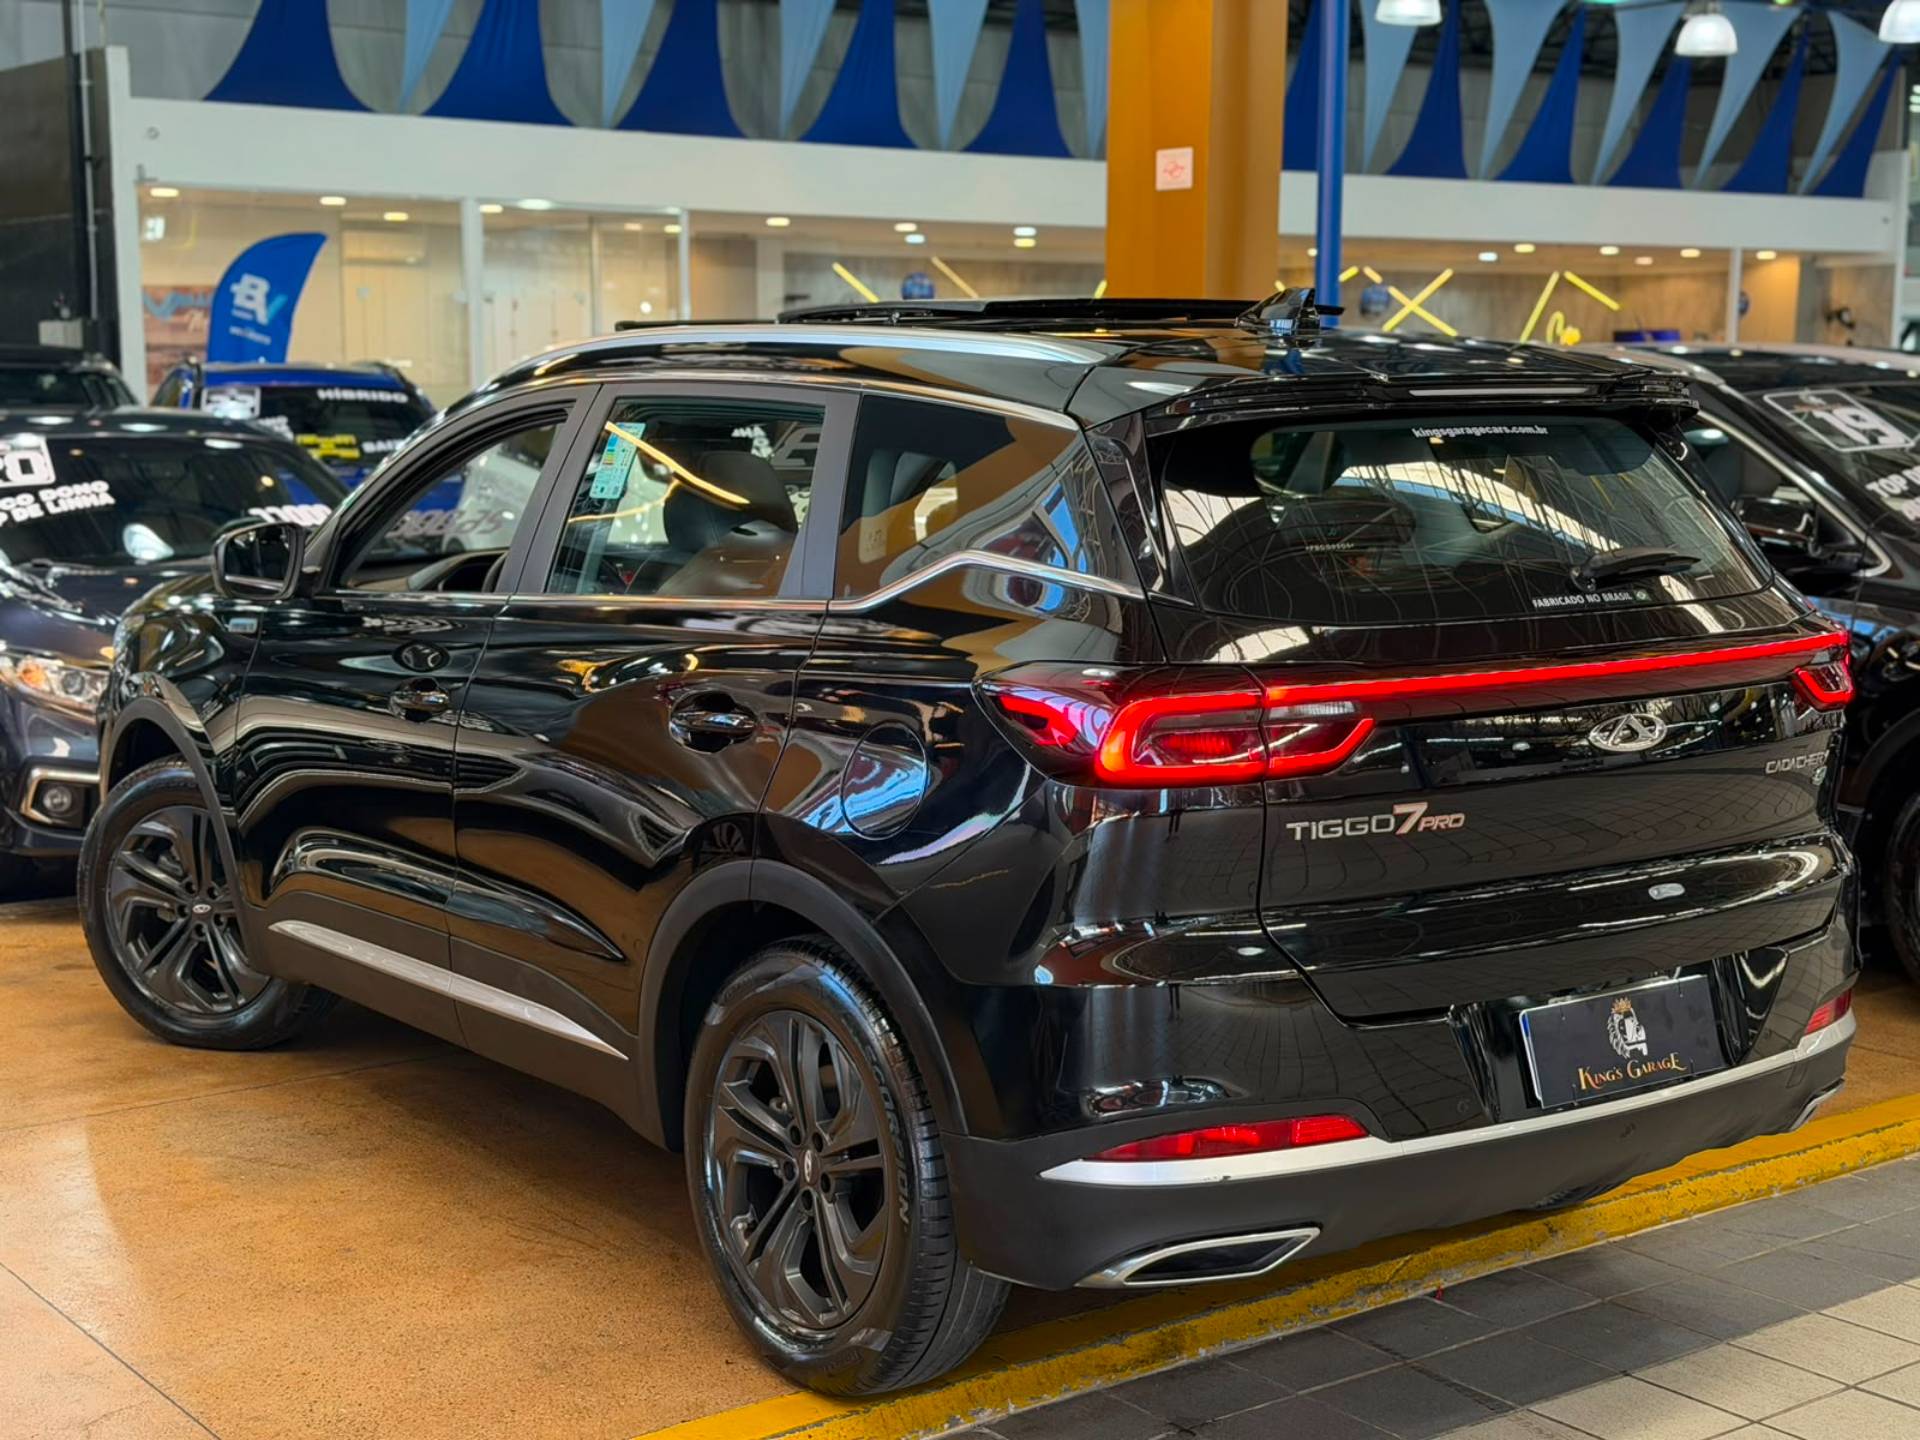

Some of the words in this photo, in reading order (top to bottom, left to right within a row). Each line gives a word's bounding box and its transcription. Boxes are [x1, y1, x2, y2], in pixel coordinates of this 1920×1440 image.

[1411, 425, 1548, 438] kingsgaragecars.com.br
[1811, 406, 1906, 446] 19
[38, 480, 109, 503] DONO
[1865, 473, 1909, 498] TOP
[45, 493, 115, 514] LINHA
[1532, 595, 1585, 608] FABRICADO
[1585, 593, 1601, 603] NO
[1602, 592, 1632, 602] BRASIL
[1286, 814, 1395, 841] TIGGO
[1393, 801, 1428, 835] 7
[1417, 813, 1465, 832] PRO
[1578, 1066, 1623, 1091] KING'S
[1626, 1052, 1687, 1078] GARAGE
